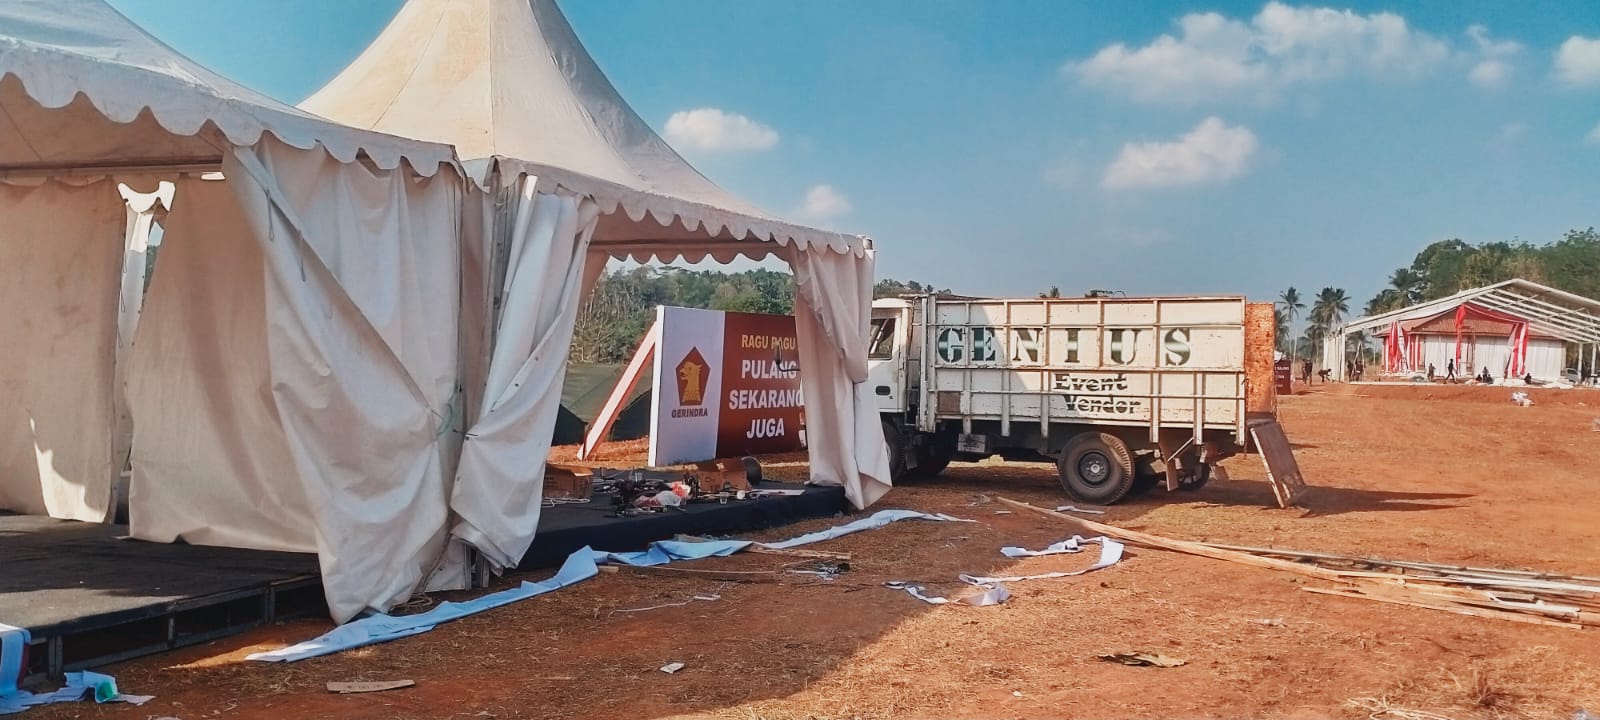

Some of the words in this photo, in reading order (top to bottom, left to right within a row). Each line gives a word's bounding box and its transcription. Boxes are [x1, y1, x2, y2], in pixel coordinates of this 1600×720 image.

[741, 334, 769, 350] RAGU
[937, 326, 1191, 366] GENIUS
[741, 359, 797, 379] PULANG
[1053, 373, 1128, 392] Event
[671, 408, 708, 418] GERINDRA
[1062, 394, 1141, 414] Vendor
[746, 417, 785, 439] JUGA
